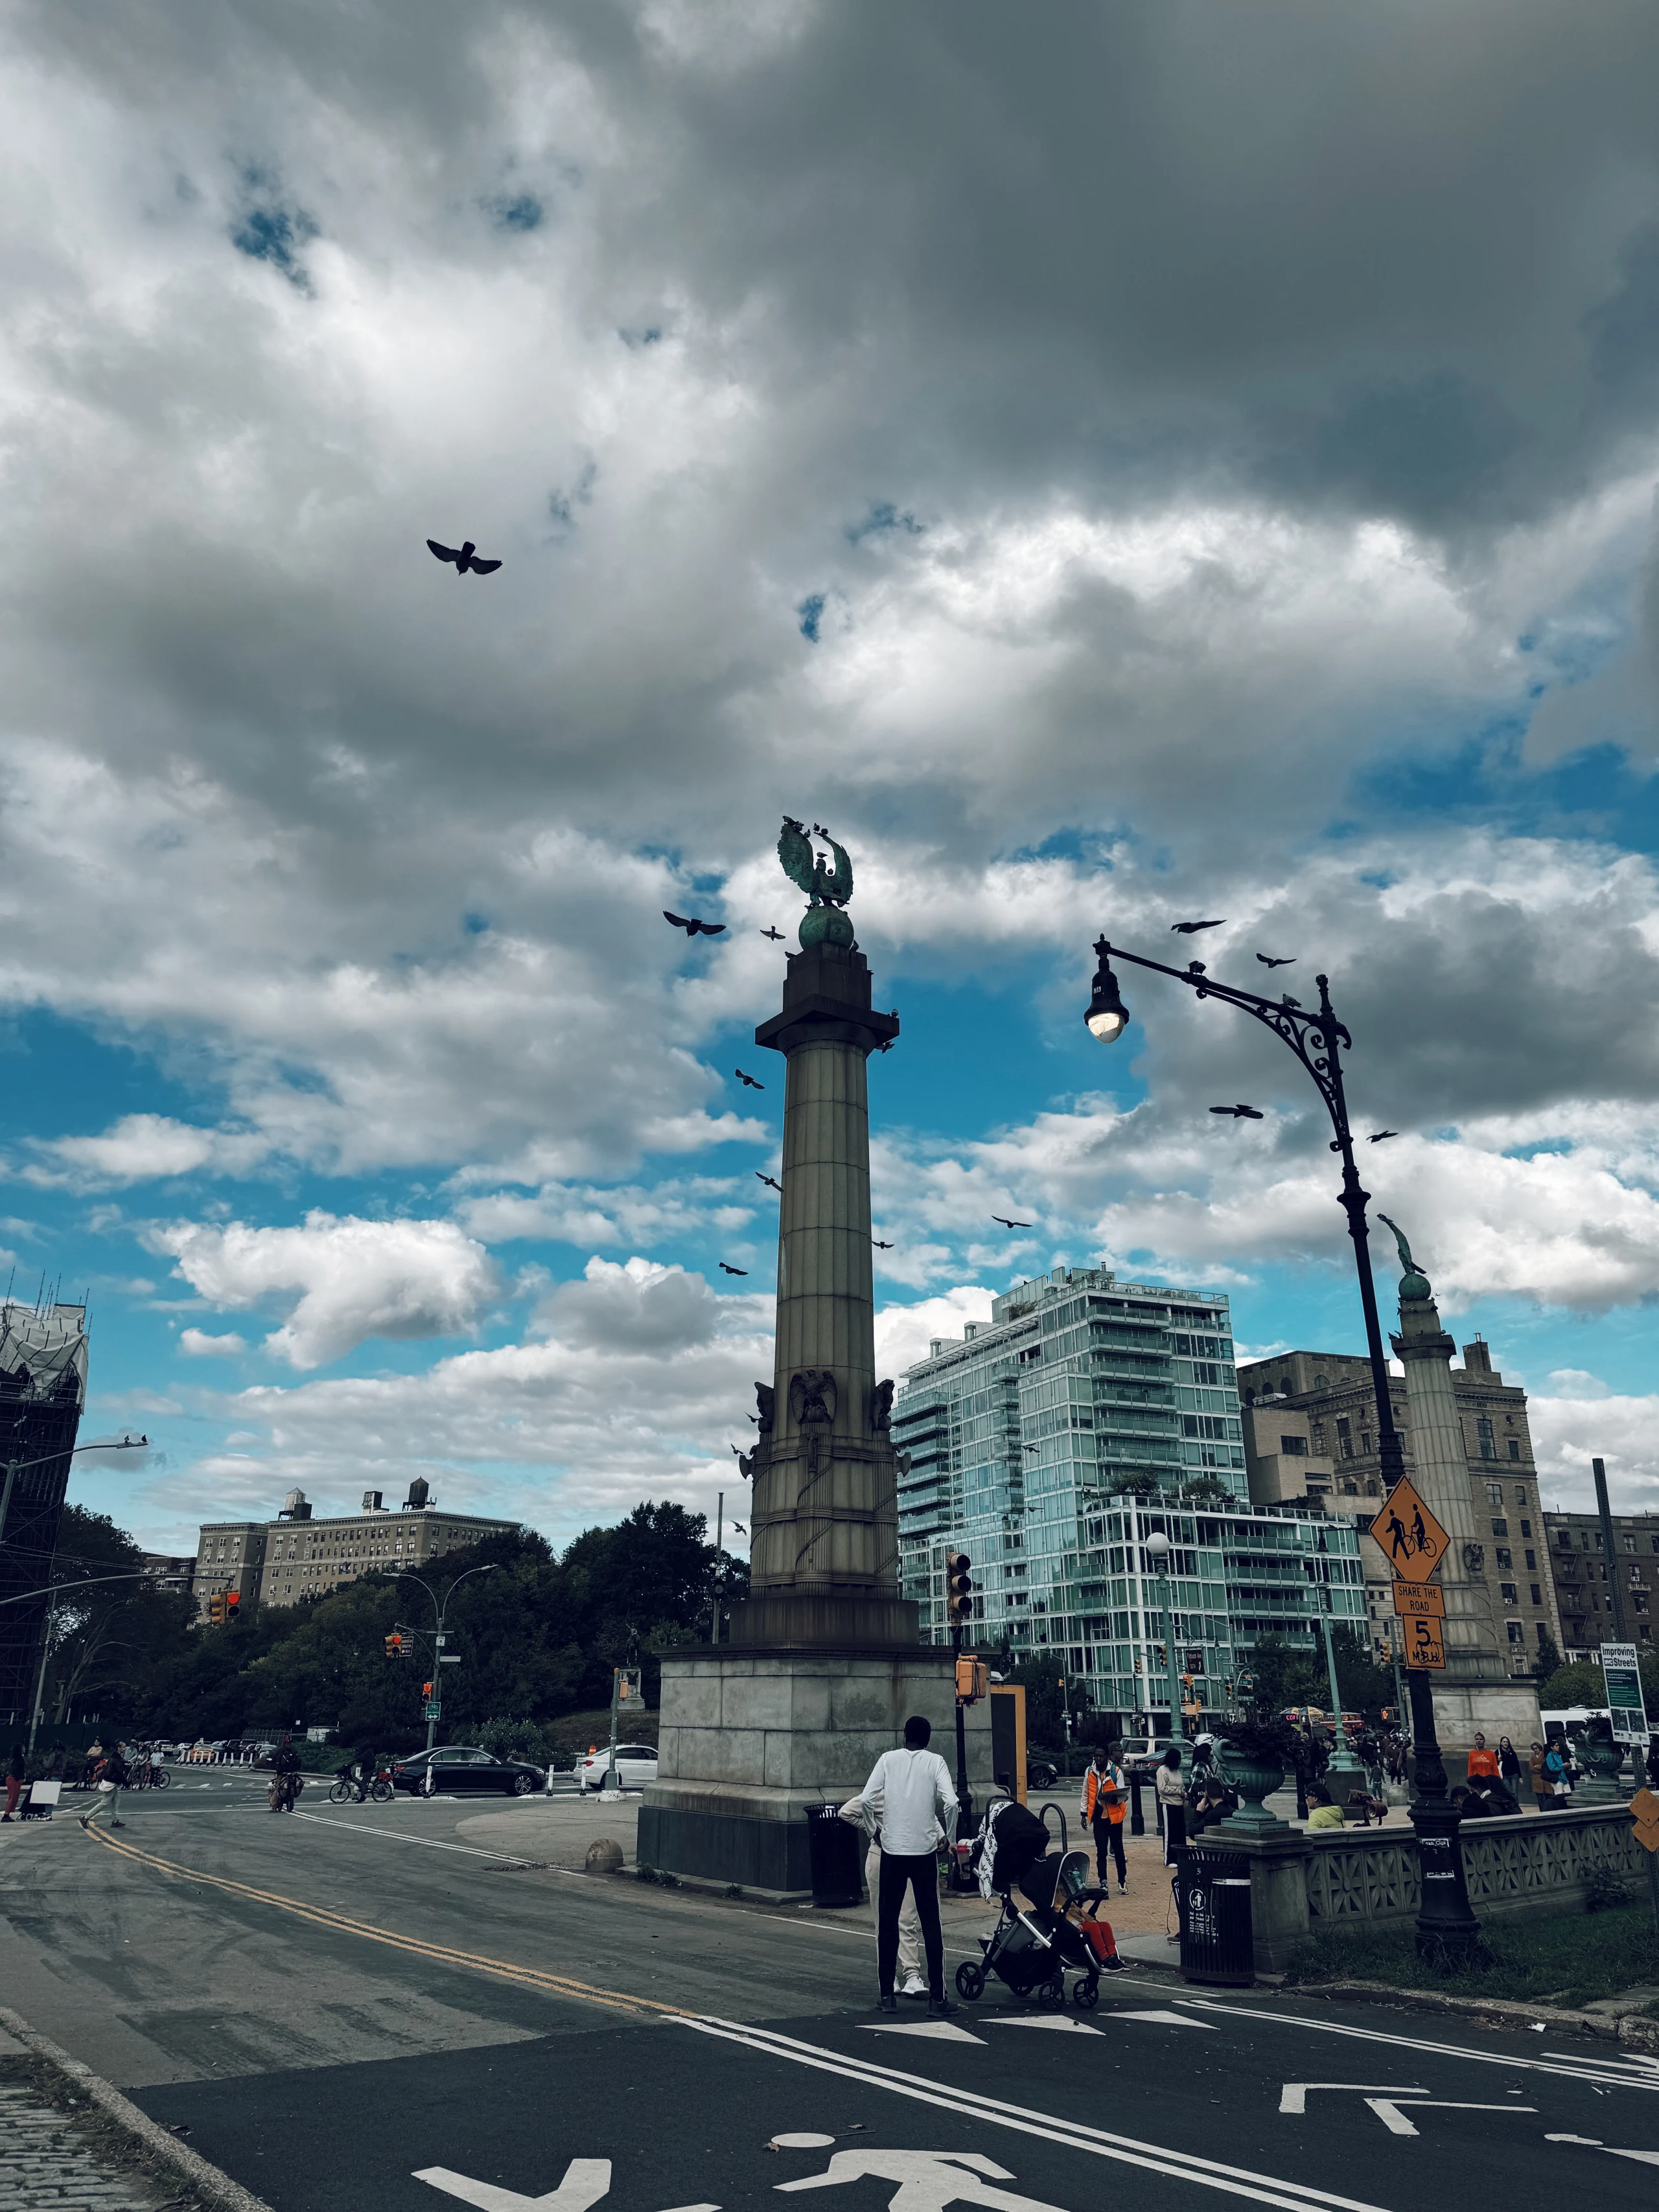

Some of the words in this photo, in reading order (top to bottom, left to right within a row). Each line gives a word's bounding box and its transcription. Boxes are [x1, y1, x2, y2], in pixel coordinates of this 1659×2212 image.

[1398, 1585, 1422, 1598] SHARE
[1424, 1588, 1438, 1599] THE
[1410, 1600, 1430, 1611] ROAD
[1415, 1620, 1431, 1647] 5
[1602, 1646, 1635, 1658] Improving
[1614, 1658, 1636, 1667] Streets
